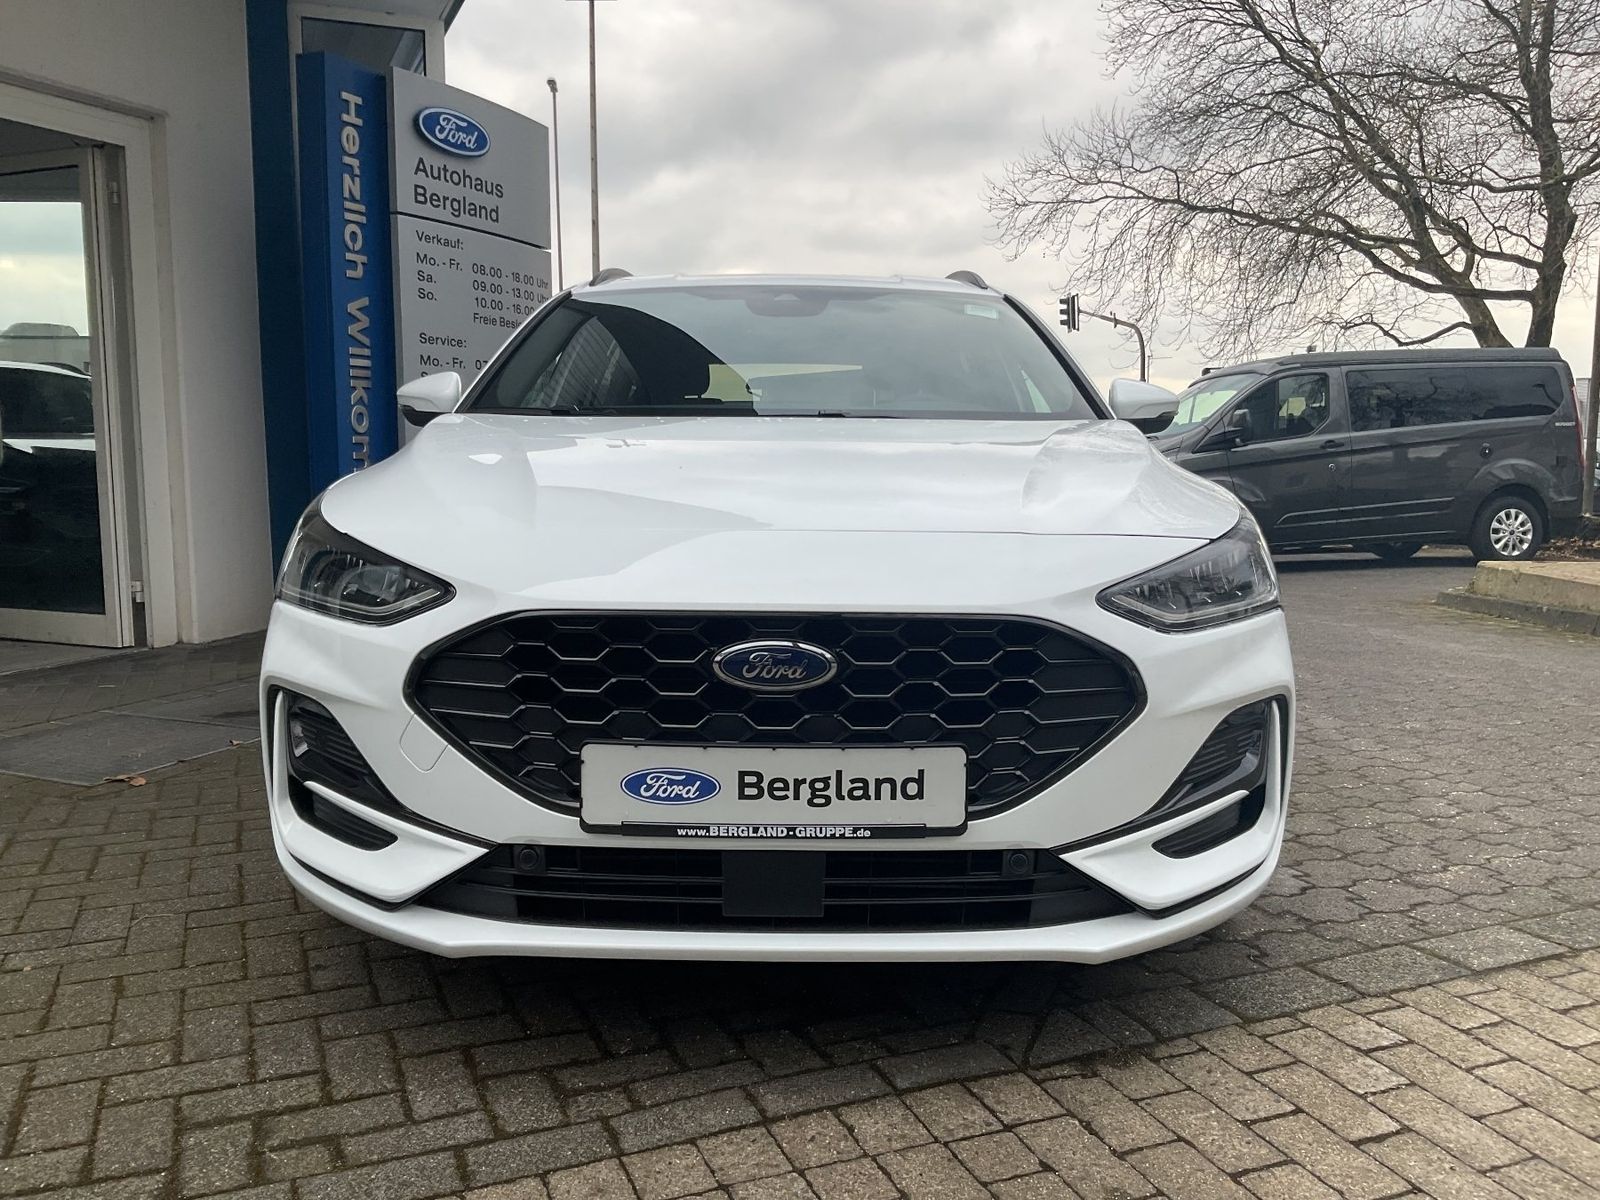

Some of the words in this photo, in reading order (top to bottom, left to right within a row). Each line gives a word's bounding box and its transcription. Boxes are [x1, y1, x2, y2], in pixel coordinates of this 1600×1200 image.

[435, 114, 478, 150] Ford
[340, 91, 368, 280] Herzlich
[413, 156, 504, 199] Autohaus
[413, 184, 500, 224] Bergland
[415, 230, 464, 250] Verkauf:
[416, 252, 439, 267] Mo.
[449, 258, 463, 272] Fr.
[472, 263, 502, 279] 08.00
[511, 271, 534, 286] 18.00
[536, 277, 549, 289] Uhr
[417, 270, 437, 284] Sa.
[472, 279, 503, 295] 09.00
[512, 287, 534, 302] 13.00
[417, 288, 437, 301] So.
[475, 296, 503, 311] 10.00
[473, 312, 497, 327] Freie
[419, 332, 467, 348] Service:
[420, 354, 443, 367] Mo.
[452, 357, 466, 369] Fr.
[742, 651, 808, 681] Ford
[640, 771, 701, 799] Ford
[736, 768, 925, 808] Bergland
